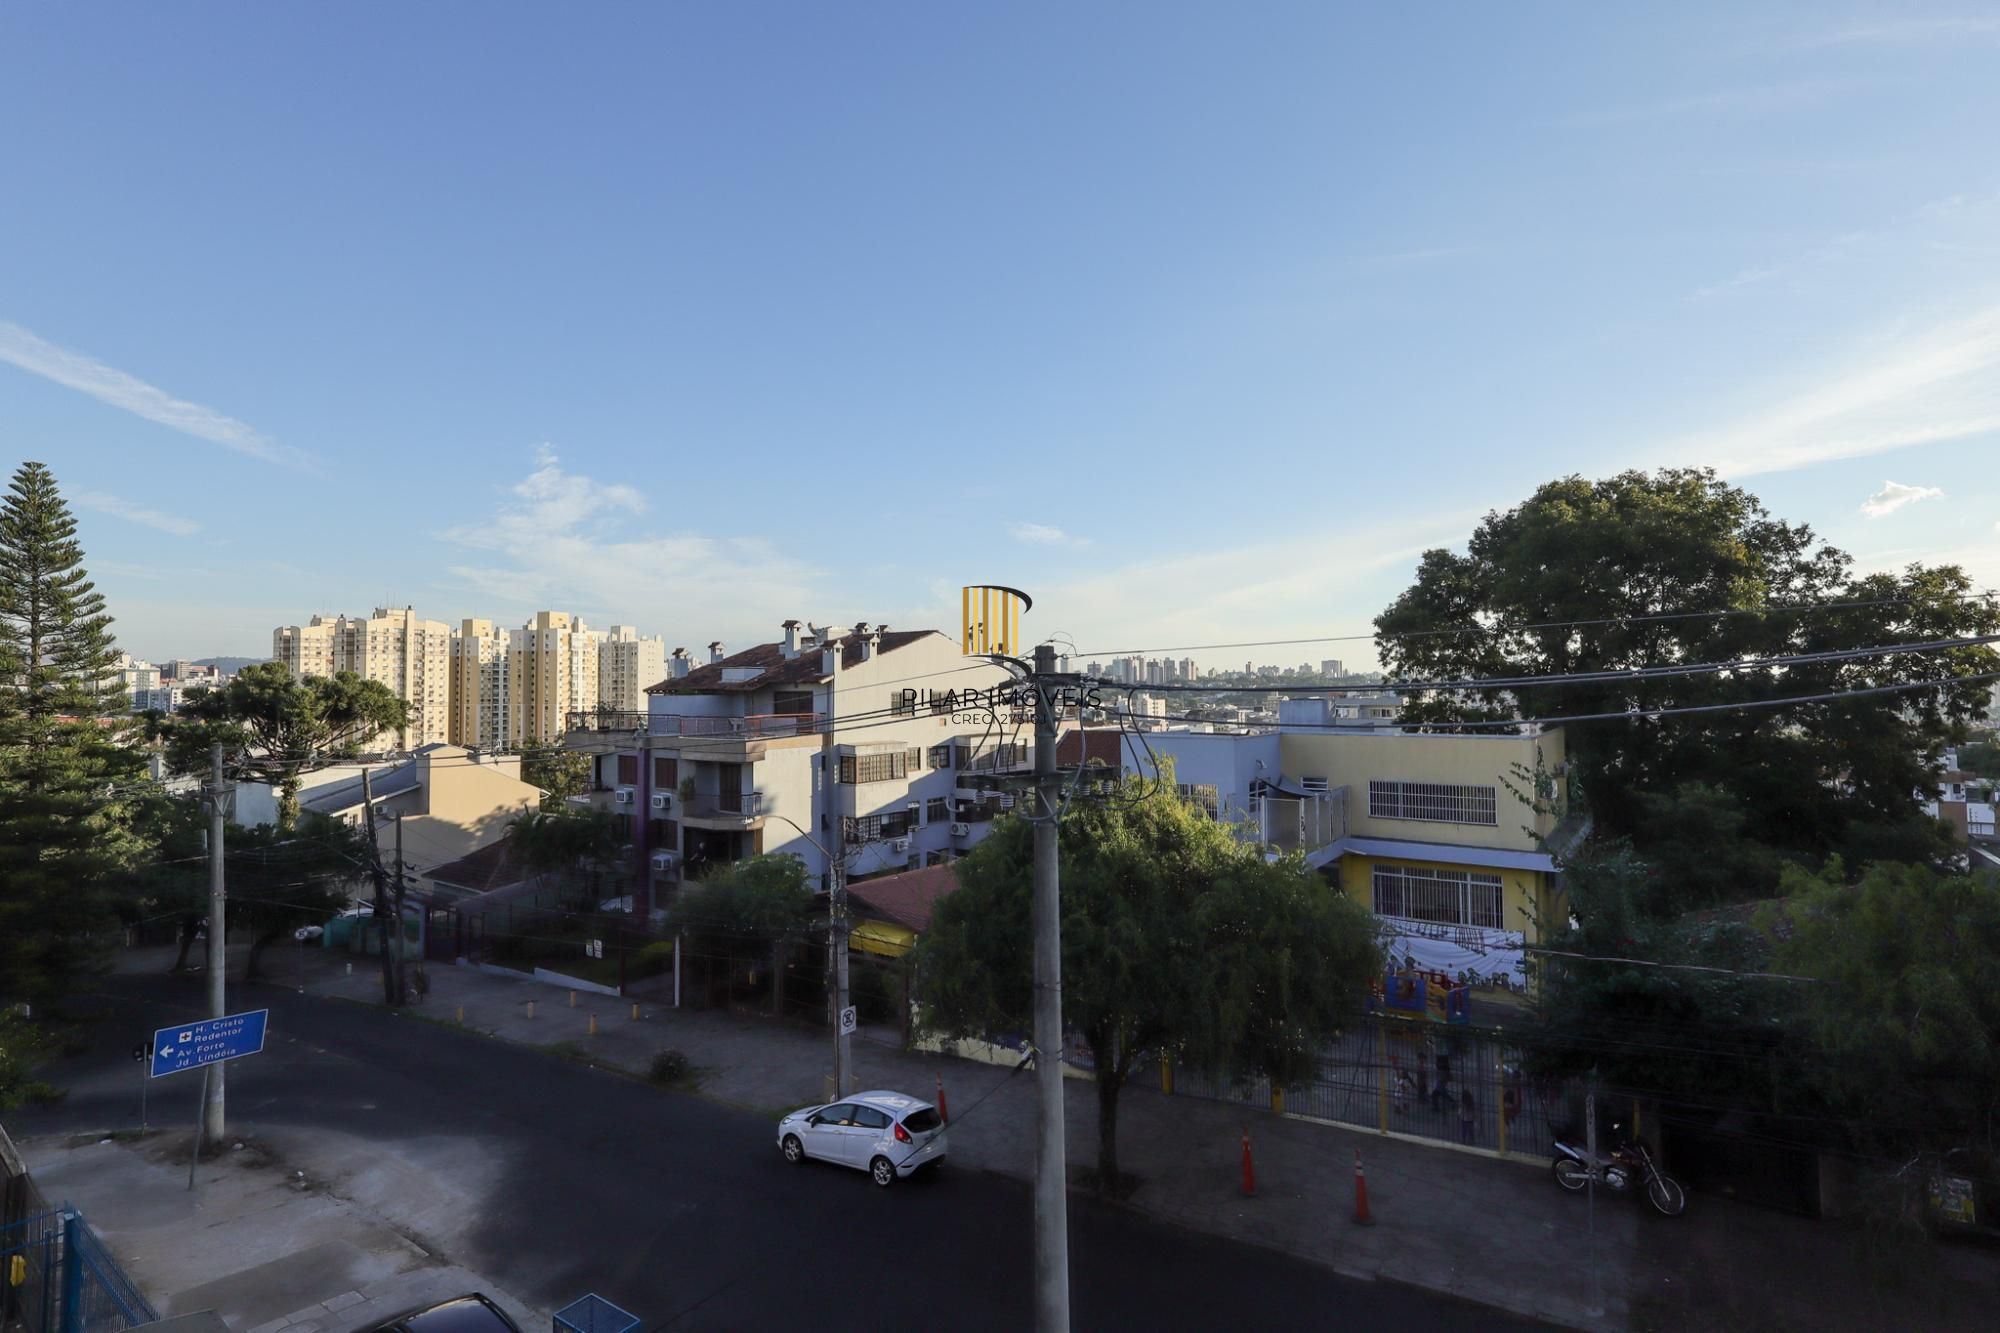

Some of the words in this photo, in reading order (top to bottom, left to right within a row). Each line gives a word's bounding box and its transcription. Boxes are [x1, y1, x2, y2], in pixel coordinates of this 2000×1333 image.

[195, 1025, 207, 1034] H.
[212, 1018, 244, 1030] Cristo
[194, 1027, 243, 1043] Redentor
[176, 1059, 192, 1068] Jd.
[198, 1048, 236, 1062] Lindóia
